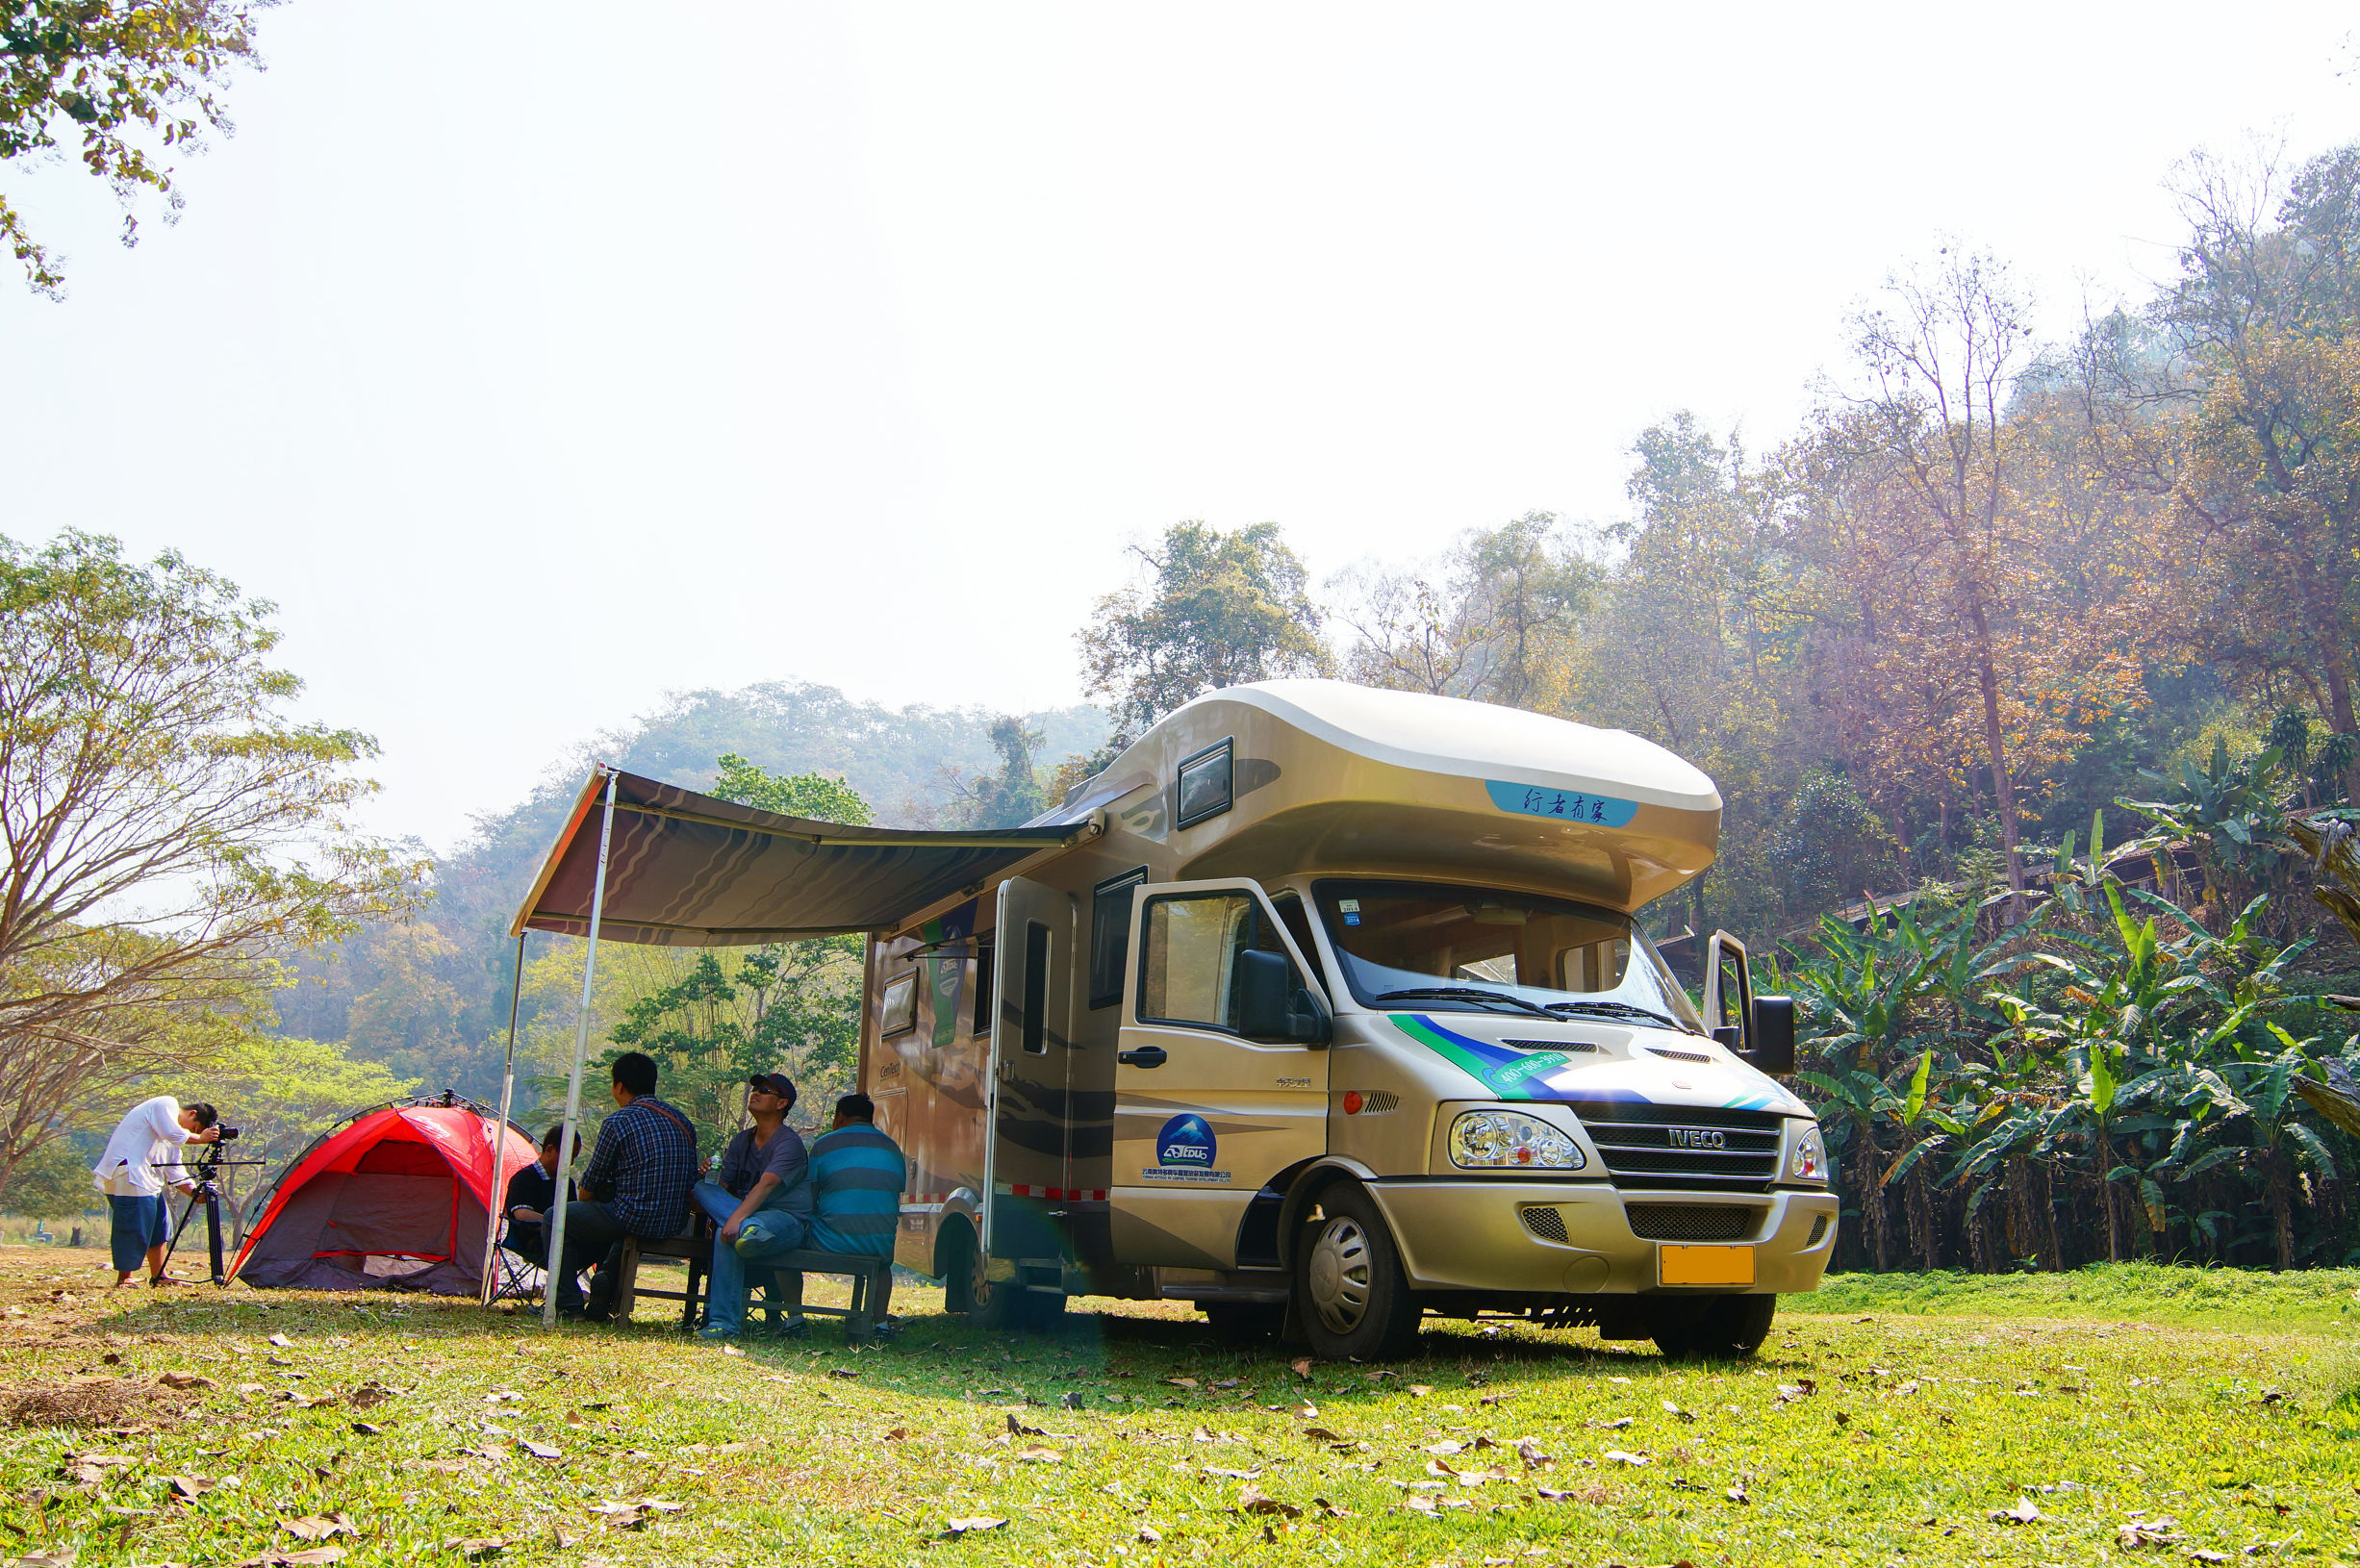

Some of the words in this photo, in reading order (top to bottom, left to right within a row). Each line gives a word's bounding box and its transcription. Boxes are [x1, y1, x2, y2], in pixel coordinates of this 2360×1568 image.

[1523, 788, 1609, 823] 行者有家
[1668, 1129, 1726, 1149] IVECO
